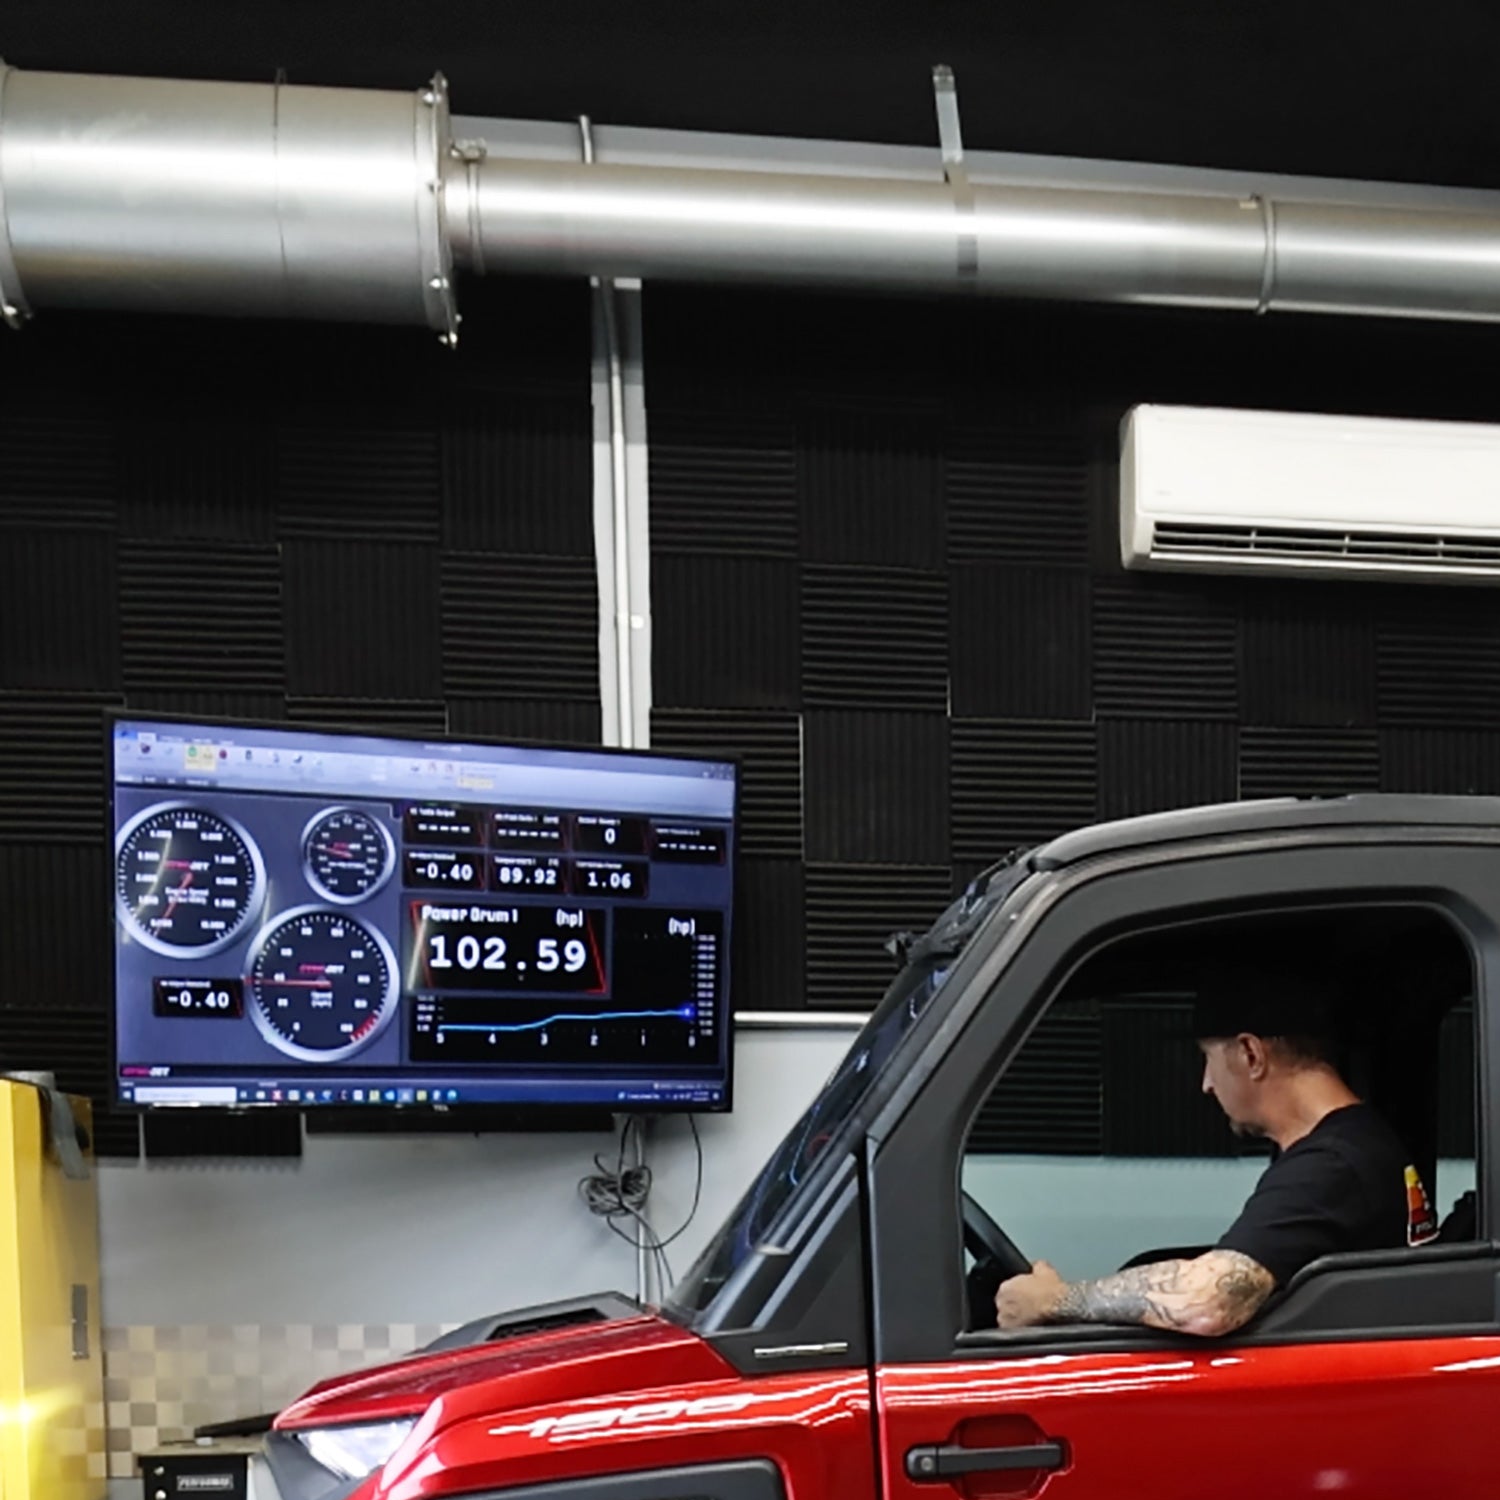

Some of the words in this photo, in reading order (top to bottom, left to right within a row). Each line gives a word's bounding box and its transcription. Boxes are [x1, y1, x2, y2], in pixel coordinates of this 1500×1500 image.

[604, 828, 616, 845] 0
[416, 862, 474, 882] -0.40
[499, 866, 557, 886] 89.92
[587, 871, 632, 890] 1.06
[421, 904, 468, 922] Power
[470, 906, 509, 923] Drum
[555, 909, 584, 928] (hp)
[668, 917, 696, 937] (hp)
[429, 935, 588, 973] 102.59
[167, 989, 230, 1009] -0.40
